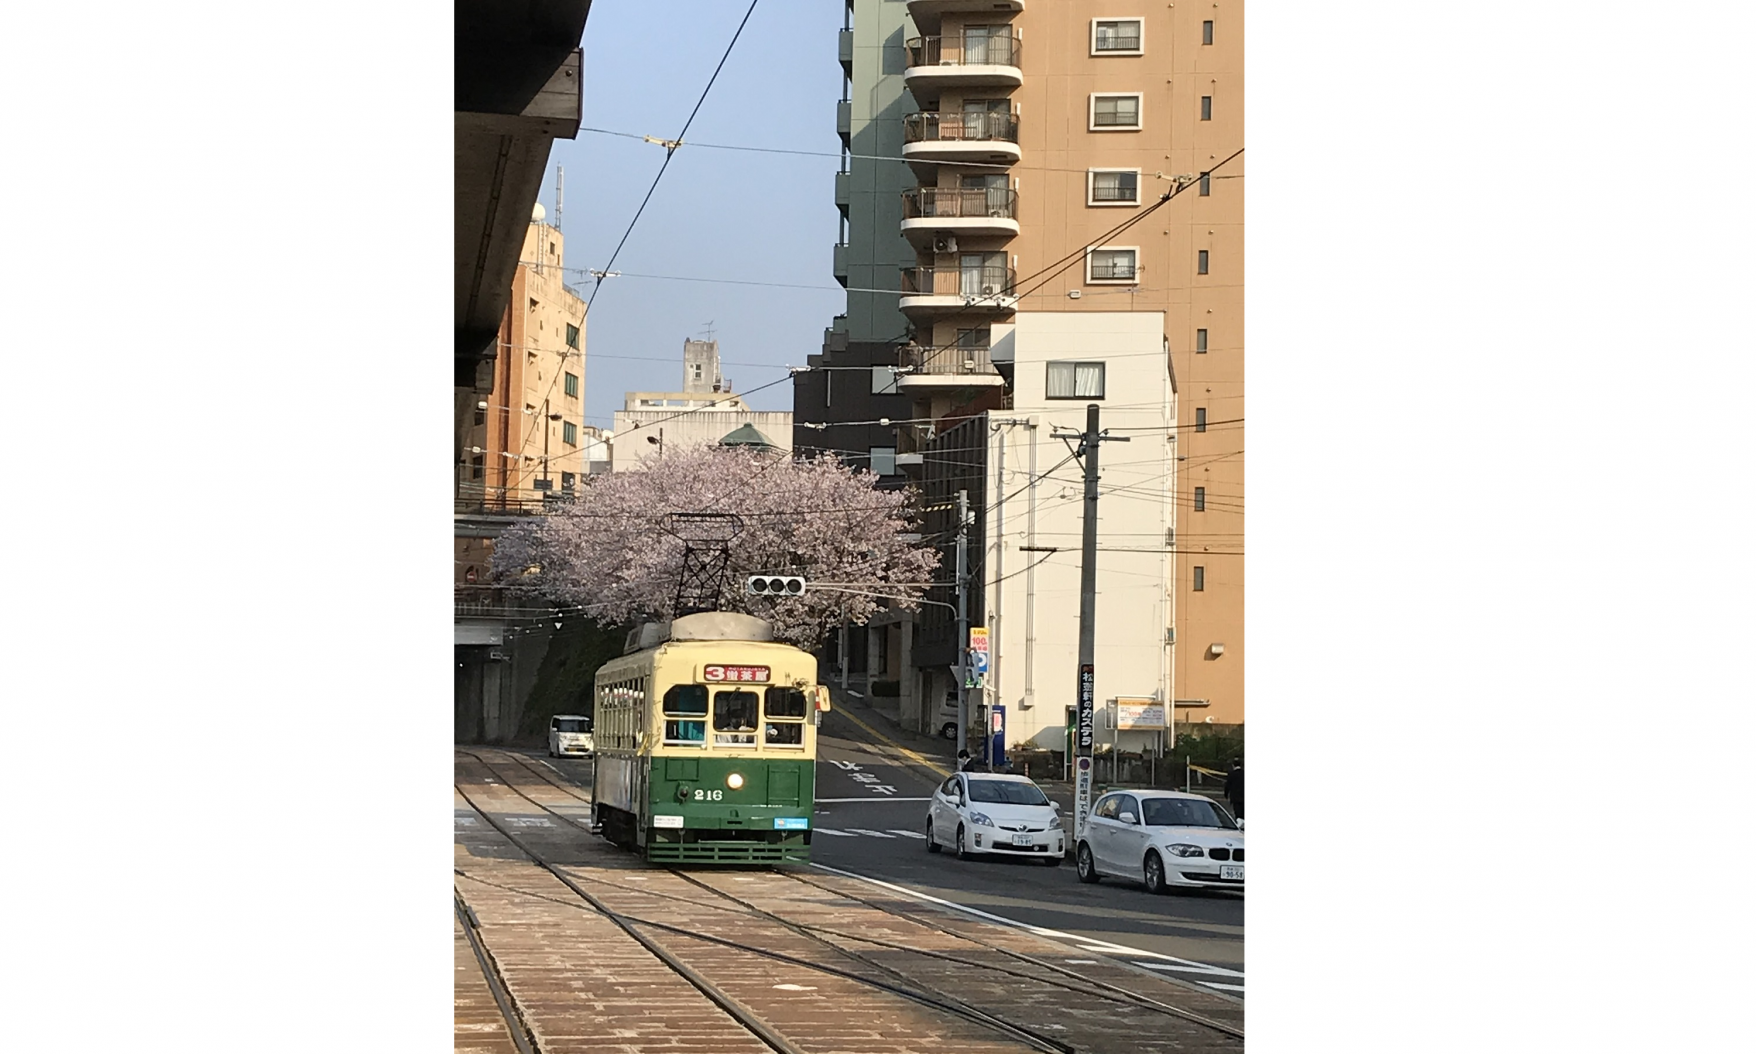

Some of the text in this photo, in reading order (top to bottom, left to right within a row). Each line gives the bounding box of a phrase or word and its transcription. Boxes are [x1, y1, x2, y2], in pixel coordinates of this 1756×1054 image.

[705, 666, 769, 681] 3 蛍茶屋
[694, 789, 723, 801] 216
